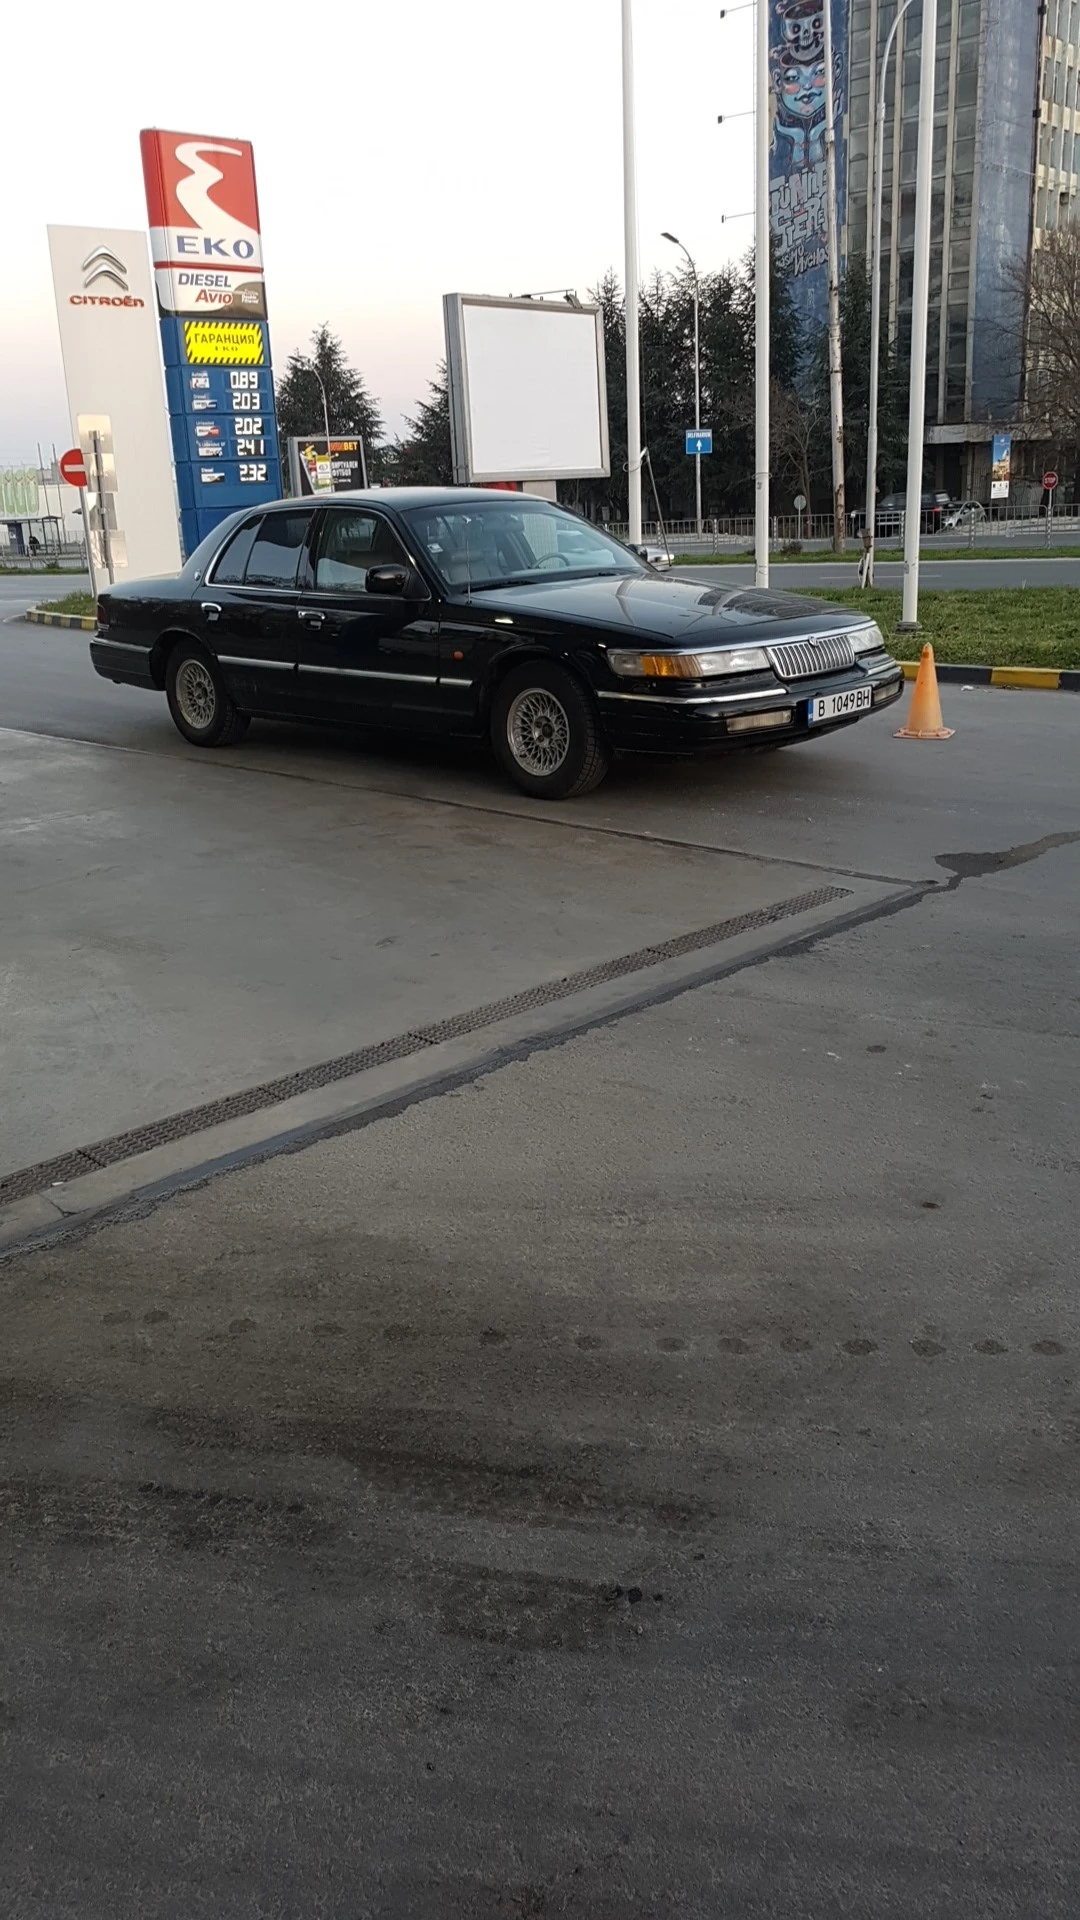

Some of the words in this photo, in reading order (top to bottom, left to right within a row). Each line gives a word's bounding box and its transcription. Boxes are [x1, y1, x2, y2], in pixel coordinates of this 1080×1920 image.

[176, 235, 254, 259] EKO
[178, 273, 232, 288] DIESEL
[69, 295, 145, 308] CITROËN
[194, 333, 255, 345] ГАРАНЦИЯ
[818, 700, 825, 717] B
